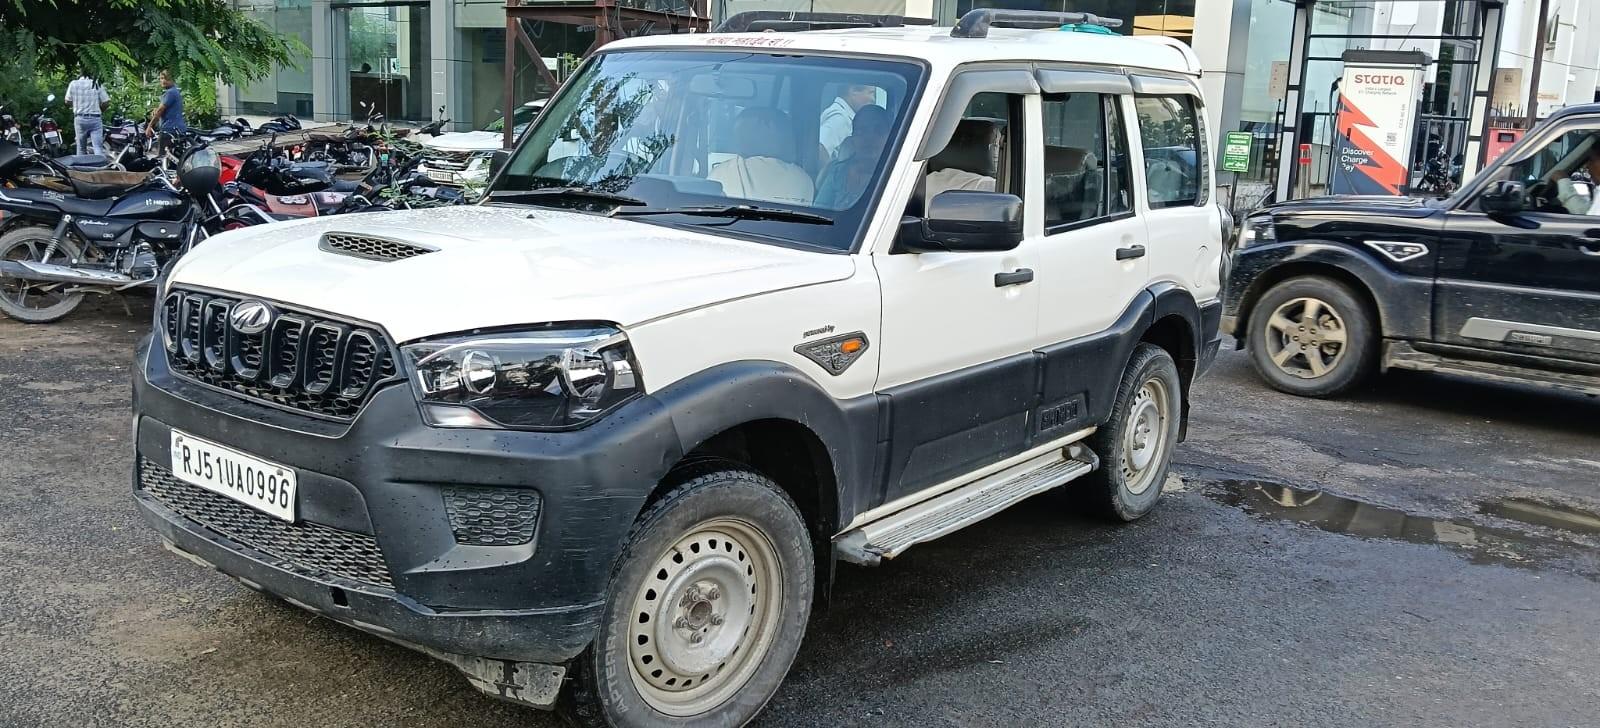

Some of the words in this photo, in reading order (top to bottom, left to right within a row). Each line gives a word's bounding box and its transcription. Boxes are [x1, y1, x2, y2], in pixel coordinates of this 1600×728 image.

[1342, 147, 1375, 156] Discover
[1341, 155, 1369, 165] Charge
[183, 444, 290, 509] RJ51UA0996
